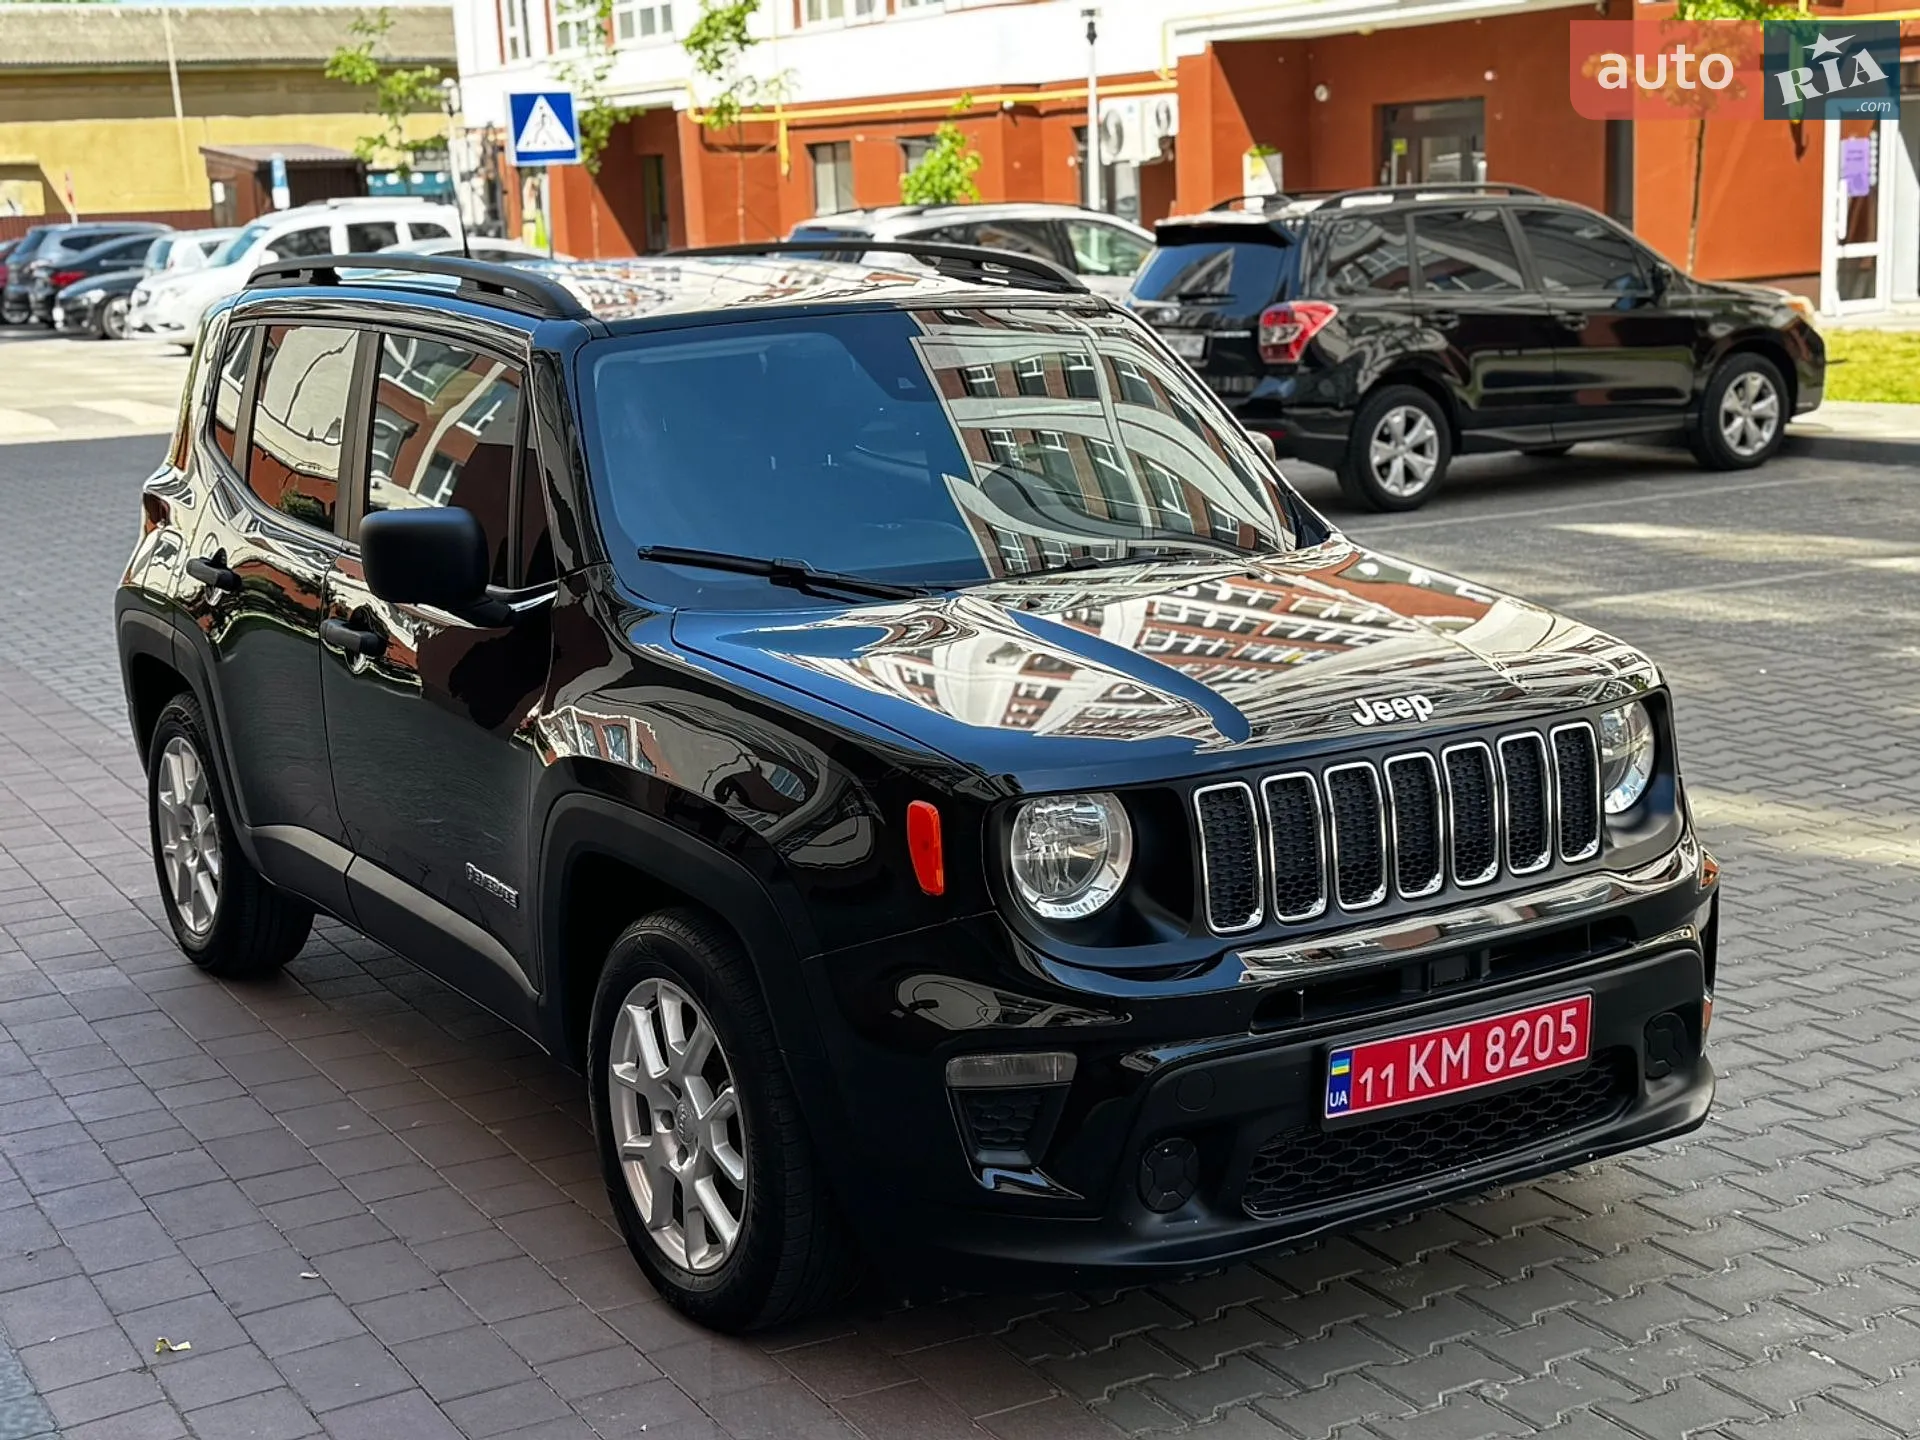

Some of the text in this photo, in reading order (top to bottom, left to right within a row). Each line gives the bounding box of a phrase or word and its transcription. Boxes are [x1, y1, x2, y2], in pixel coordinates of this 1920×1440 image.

[1352, 694, 1433, 725] Jeep
[1358, 1007, 1577, 1102] 11 KM 8205
[1329, 1090, 1348, 1107] UA
